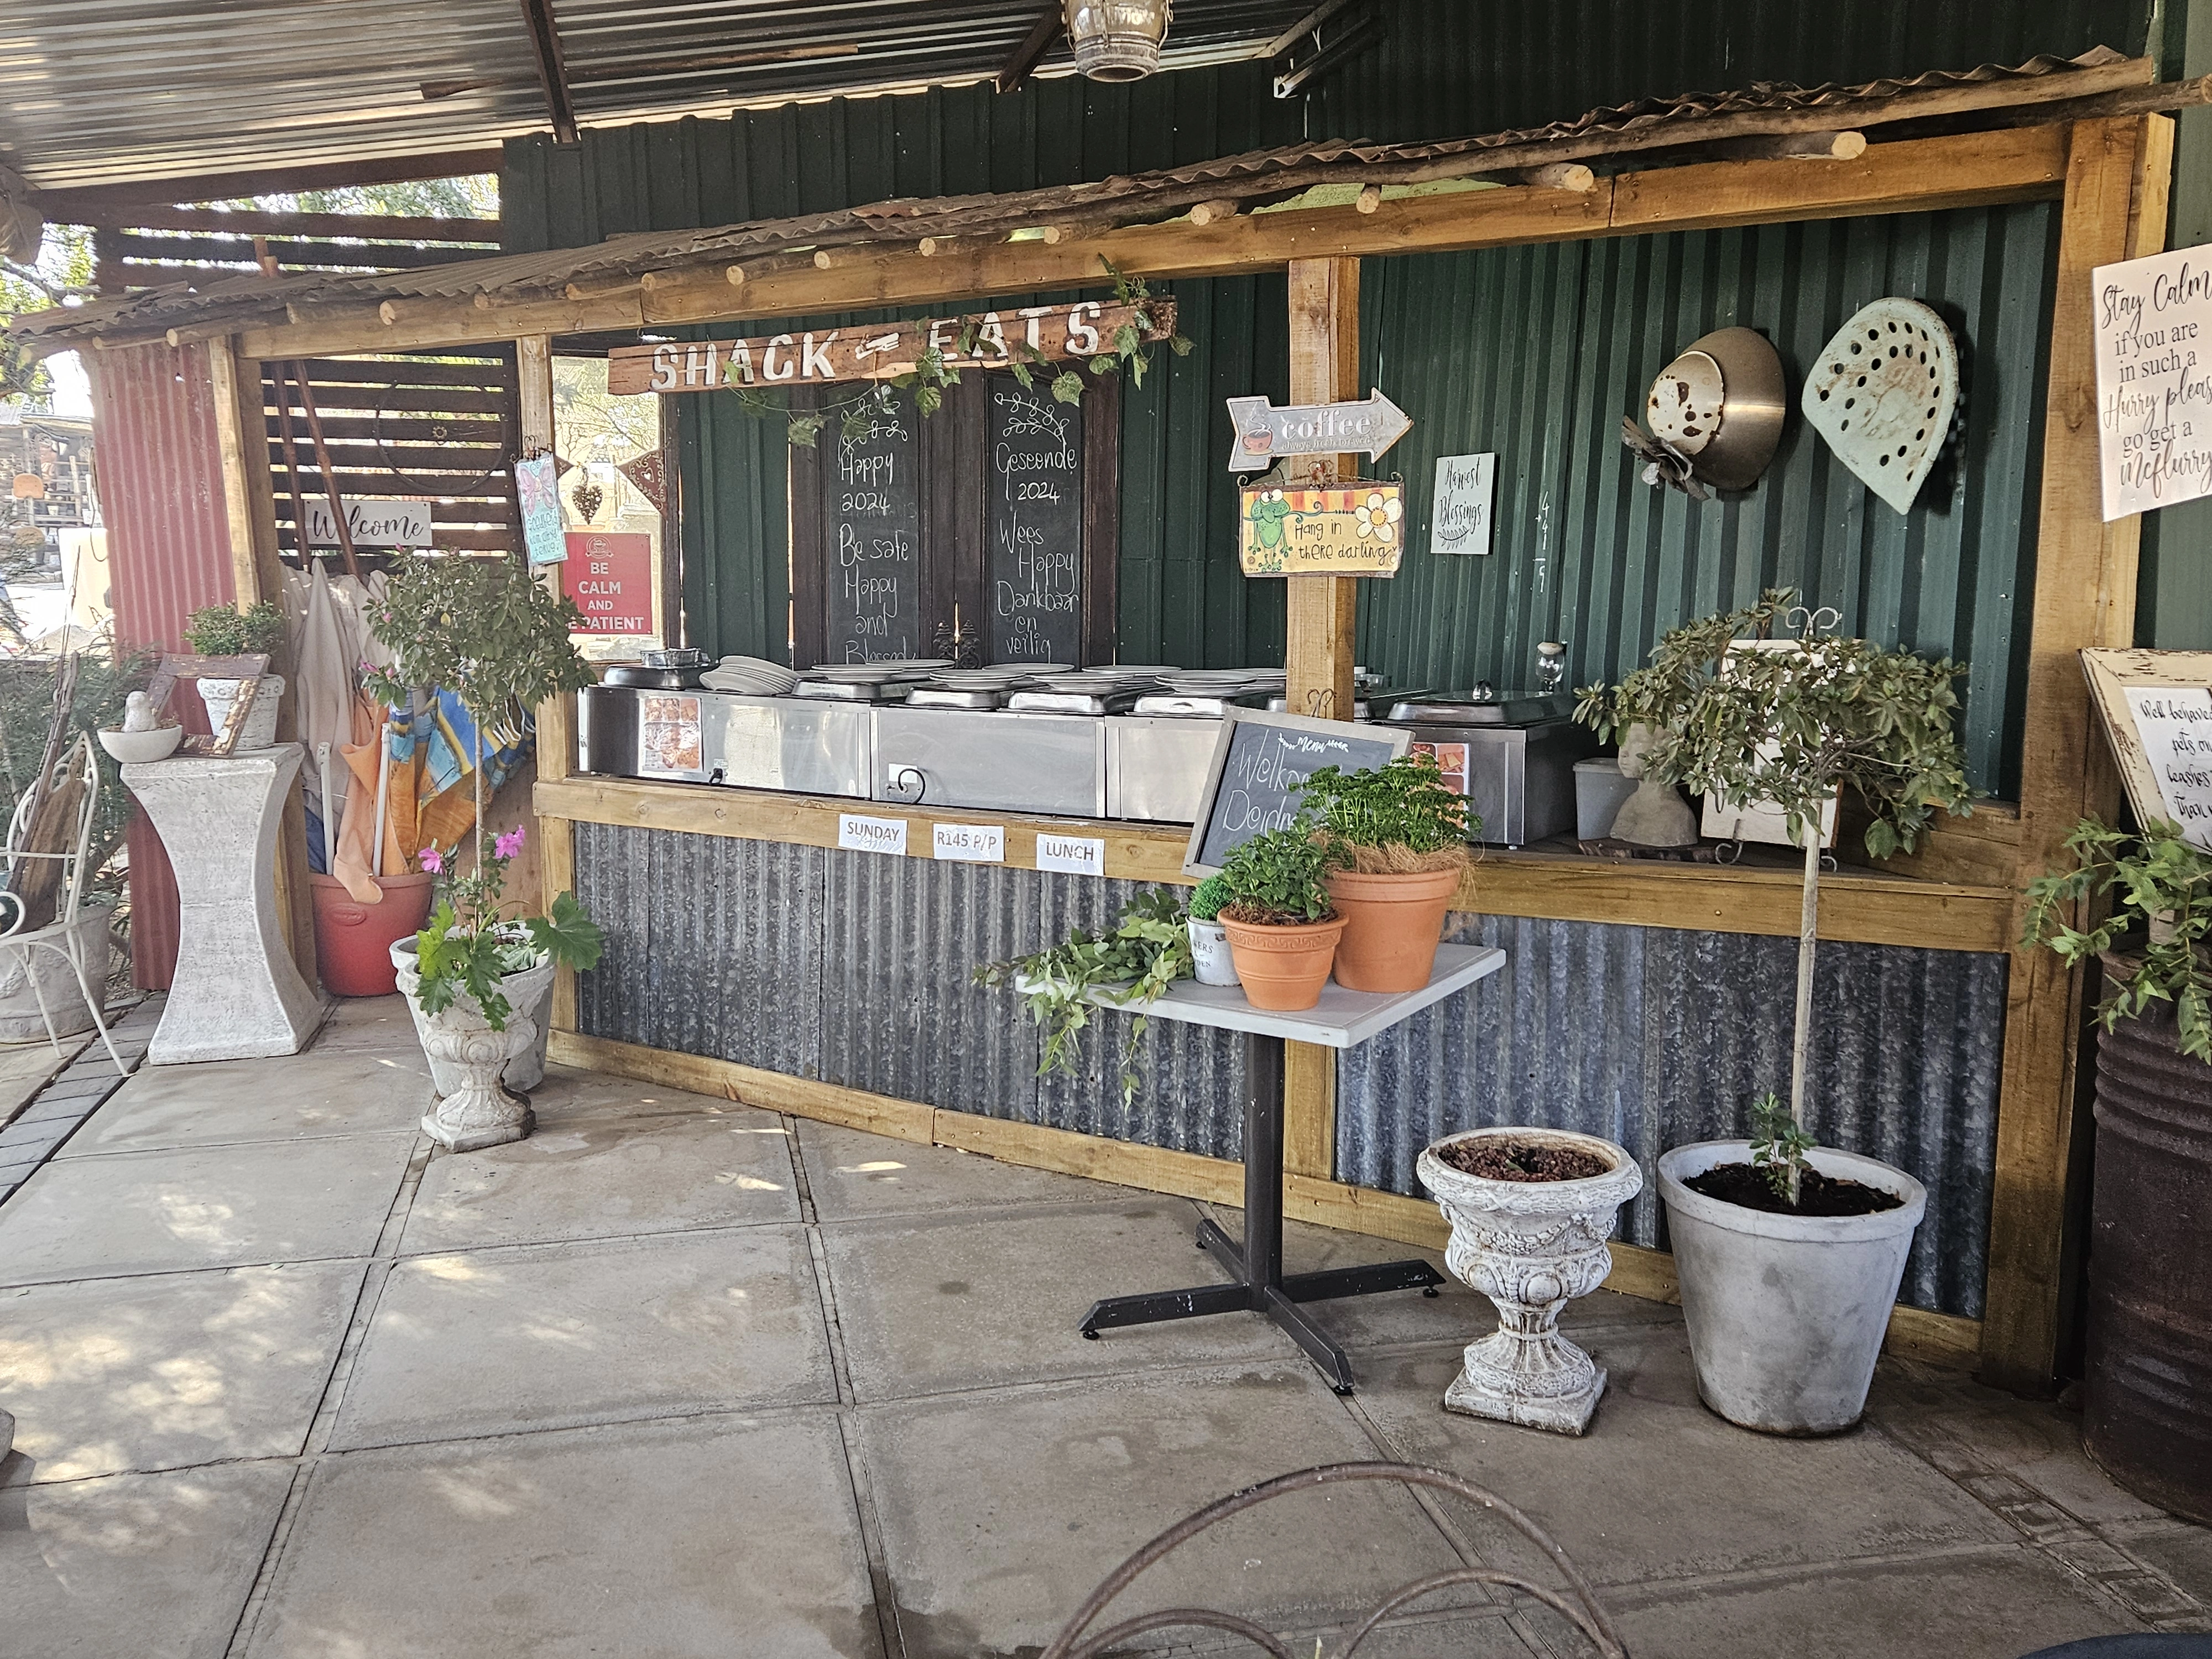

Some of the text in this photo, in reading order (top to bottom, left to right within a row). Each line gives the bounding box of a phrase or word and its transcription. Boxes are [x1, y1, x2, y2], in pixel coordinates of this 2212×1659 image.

[2102, 262, 2212, 338] Stay Calm
[651, 301, 1101, 390] SHACK EATS
[2115, 322, 2199, 358] if you are
[2119, 348, 2198, 383] in such a
[1282, 410, 1371, 439] coffee
[2104, 385, 2159, 435] Hurry
[1282, 441, 1312, 451] always
[1339, 436, 1371, 446] brewed
[2123, 421, 2193, 458] go get a
[841, 452, 893, 487] Happy
[1445, 456, 1481, 490] Harvest
[842, 493, 890, 516] 2024
[1018, 482, 1060, 505] 2024
[314, 505, 424, 540] Wlcome
[1438, 489, 1485, 535] Blessings
[839, 523, 865, 566] Be
[1000, 510, 1044, 553] Wees
[1295, 519, 1342, 541] Hang in
[591, 562, 609, 575] BE
[1338, 541, 1392, 566] darling
[1019, 543, 1074, 597] Happy
[578, 581, 621, 594] CALM
[846, 564, 898, 618] Happy
[997, 580, 1079, 615] Dankbaar
[587, 600, 613, 611] AND
[855, 602, 888, 637] and
[1015, 616, 1037, 633] en
[1006, 630, 1051, 664] veilig
[2140, 700, 2166, 719] Well
[1297, 735, 1328, 753] Menu
[2172, 728, 2195, 757] pets
[2167, 764, 2210, 787] leashes
[847, 822, 900, 841] SUNDAY
[937, 831, 997, 851] R145 P/P
[1046, 841, 1094, 862] LUNCH
